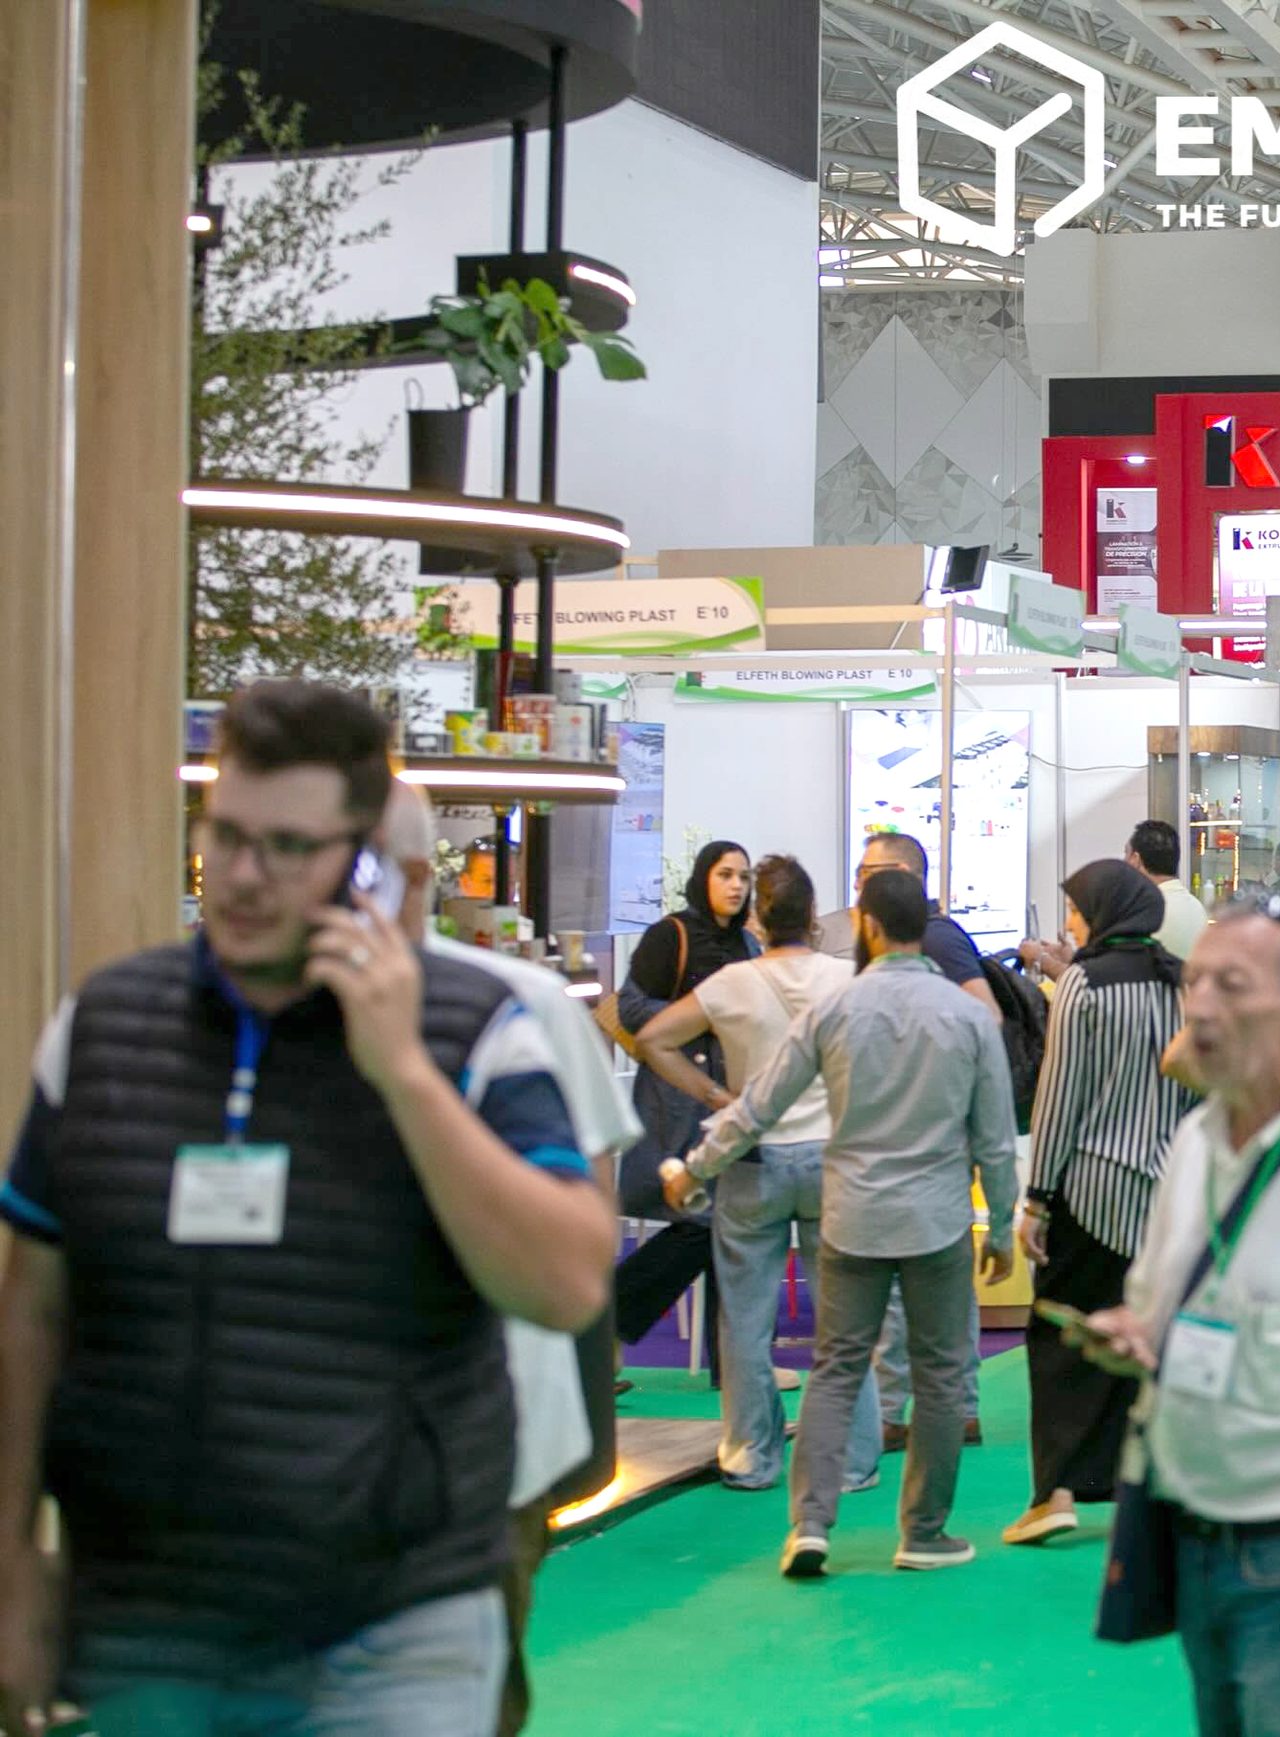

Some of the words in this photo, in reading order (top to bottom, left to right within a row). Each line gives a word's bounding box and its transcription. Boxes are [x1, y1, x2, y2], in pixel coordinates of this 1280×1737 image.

[555, 610, 625, 624] BLOWING
[628, 609, 676, 622] PLAST
[712, 605, 729, 619] 10
[736, 670, 778, 681] ELFETH
[781, 670, 834, 680] BLOWING
[836, 669, 872, 680] PLAST
[888, 668, 896, 678] E
[900, 668, 912, 678] 10
